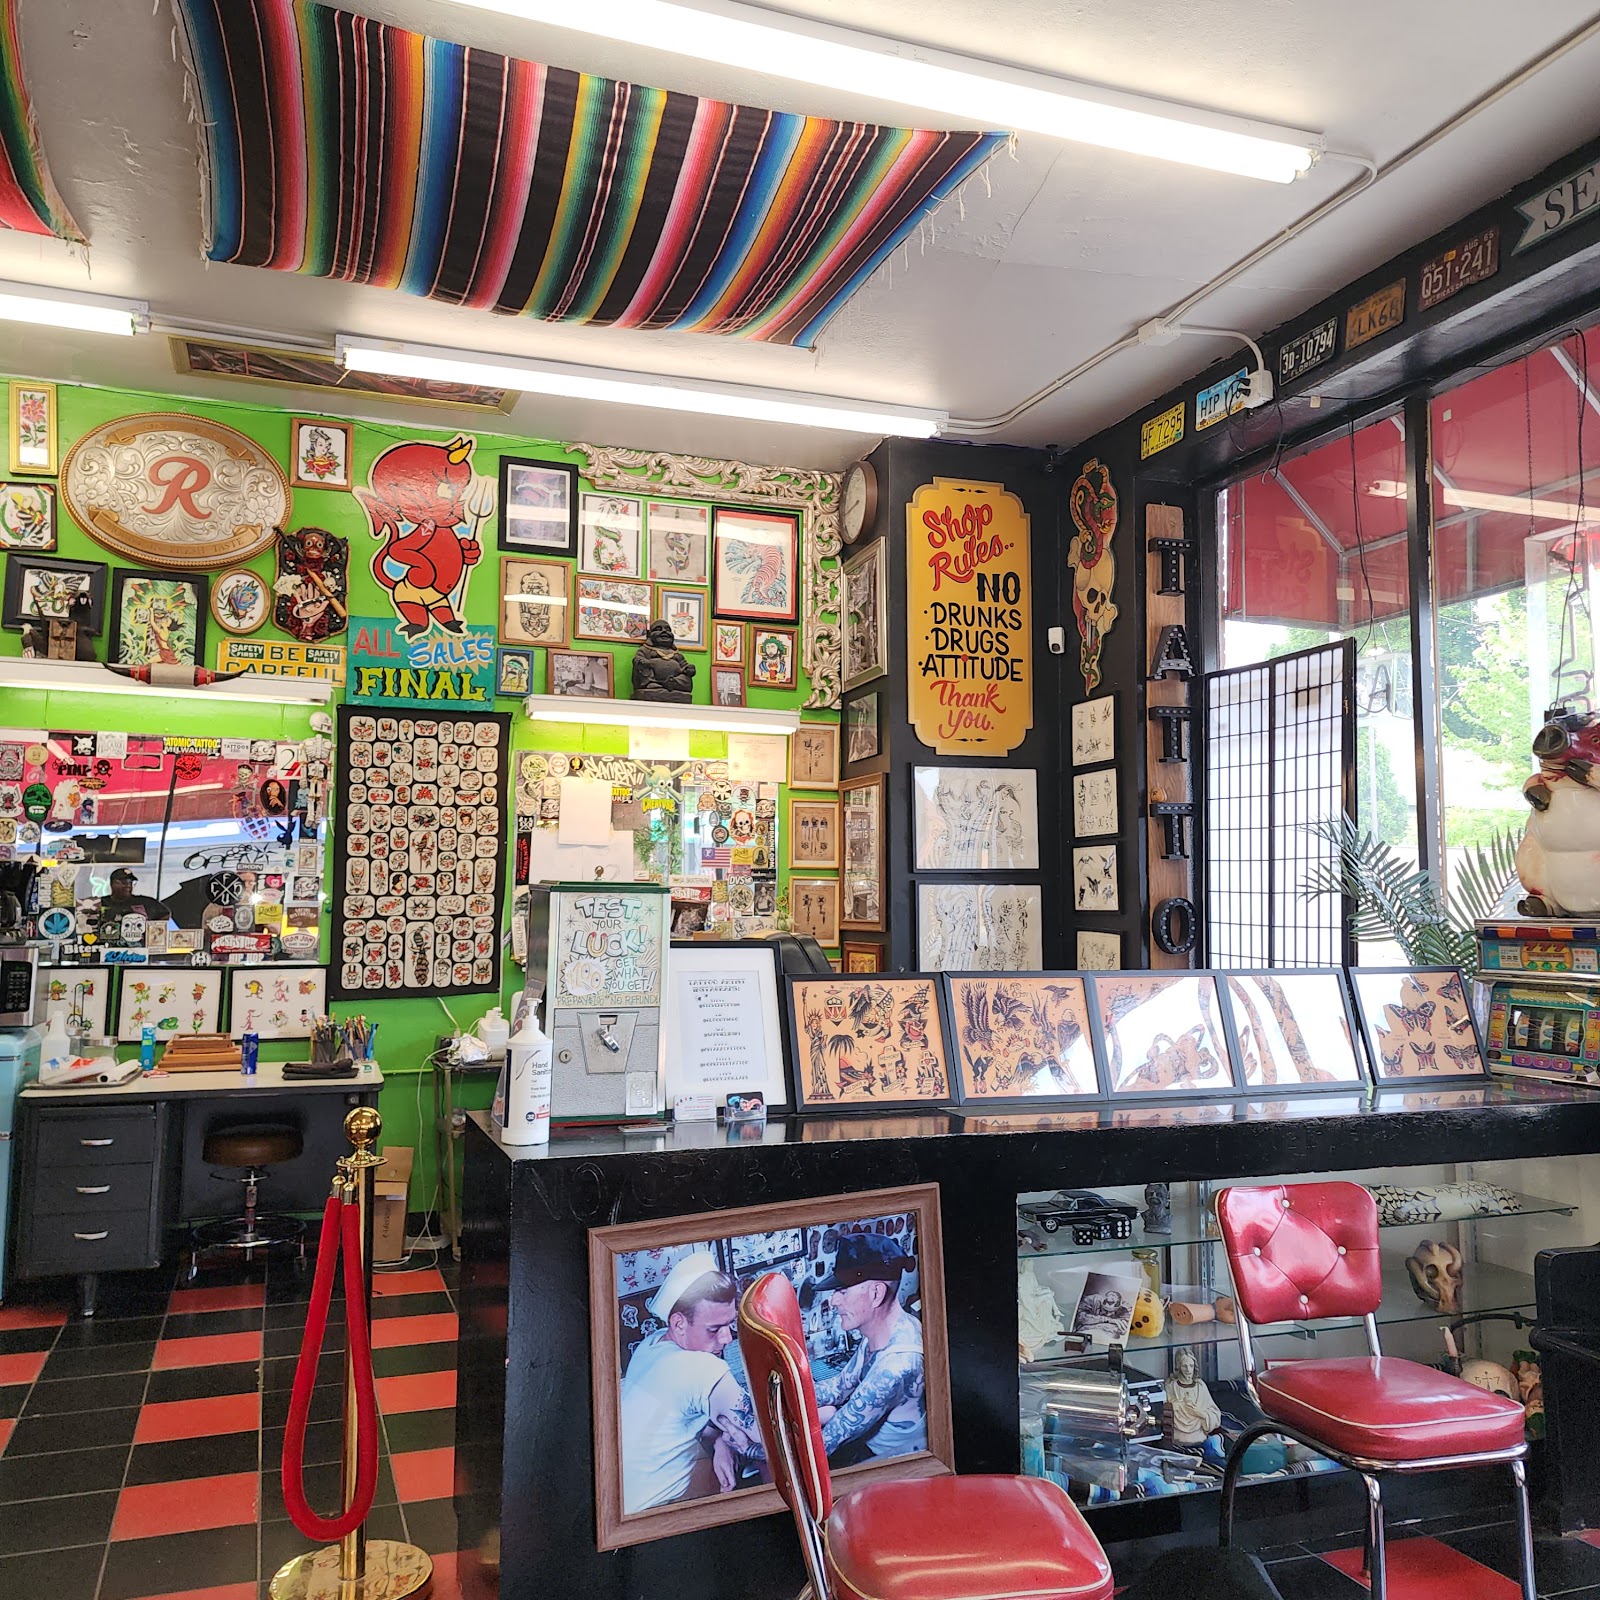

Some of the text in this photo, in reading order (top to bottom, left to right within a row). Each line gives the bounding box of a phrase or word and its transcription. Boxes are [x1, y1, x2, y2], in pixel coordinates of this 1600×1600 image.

[1290, 354, 1321, 378] FLORIDA
[1200, 393, 1220, 419] HIP
[1157, 411, 1183, 443] 7295
[141, 456, 212, 520] R
[922, 503, 993, 549] Shop
[976, 571, 1021, 606] NO
[930, 602, 1022, 631] DRUNKS
[352, 626, 494, 668] ALL SALES
[930, 627, 1010, 656] DRUGS
[230, 644, 264, 656] SAFETY
[236, 651, 259, 659] FIRST
[269, 646, 300, 662] BE
[307, 649, 340, 661] SAFETY
[313, 656, 335, 664] FIRST
[354, 665, 487, 702] FINAL
[929, 679, 1007, 714] Thank
[165, 736, 218, 749] ATOMIC TATTOO
[164, 746, 220, 755] MILWAUKEE
[237, 863, 264, 871] EIKON
[729, 876, 746, 885] DVS
[575, 897, 643, 919] TEST
[593, 919, 622, 931] YOUR
[77, 935, 83, 945] I
[571, 924, 649, 958] LUCK!
[615, 956, 638, 968] GET
[613, 966, 647, 979] WHAT
[611, 995, 623, 1005] NO
[531, 1061, 549, 1069] Hand
